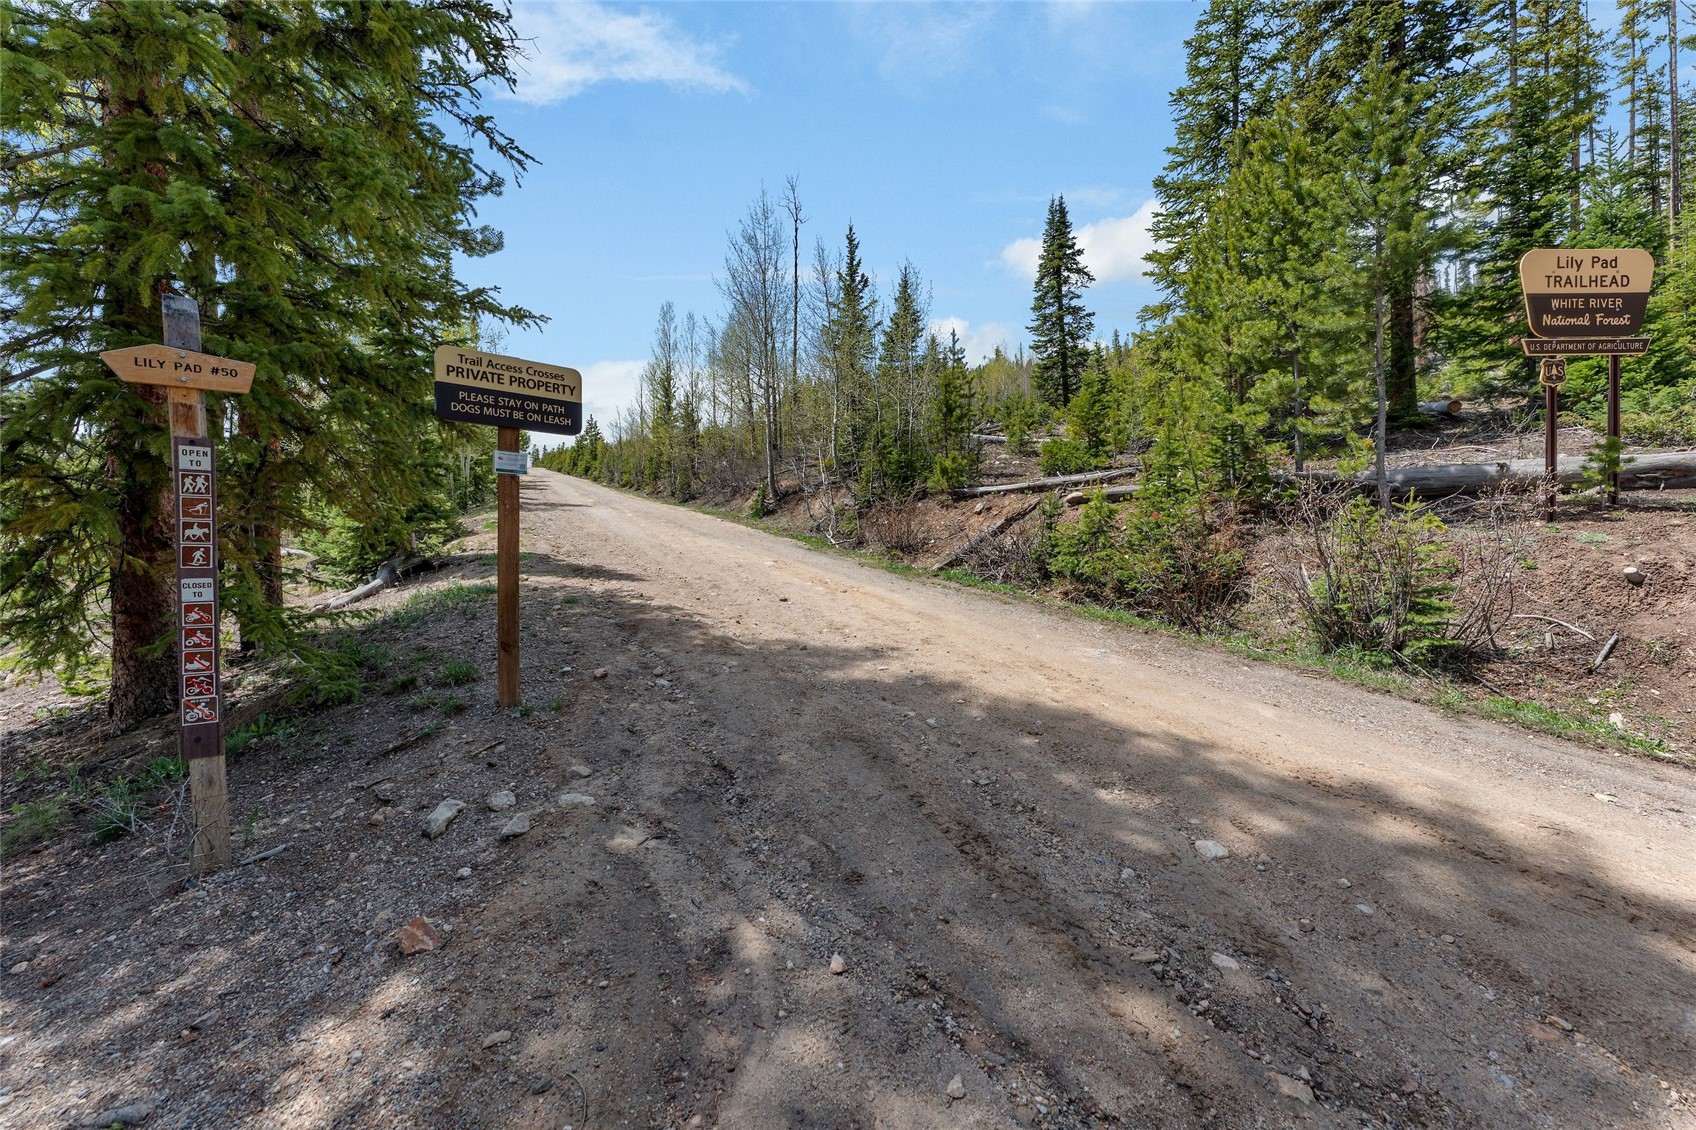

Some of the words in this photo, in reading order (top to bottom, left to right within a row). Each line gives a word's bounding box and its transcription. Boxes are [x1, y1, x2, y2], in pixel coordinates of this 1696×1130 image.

[1556, 255, 1584, 272] Lily
[1591, 255, 1618, 269] Pad
[1544, 274, 1630, 288] TRAILHEAD
[1551, 298, 1585, 309] WHITE
[1589, 298, 1623, 309] RIVER
[1542, 313, 1590, 326] National
[1595, 313, 1631, 326] Forest
[1530, 343, 1541, 351] U.S.
[1543, 343, 1586, 351] DEPARTMENT
[1587, 343, 1596, 351] OF
[1598, 342, 1644, 350] AGRICULTURE
[134, 356, 166, 369] LILY
[174, 362, 202, 374] PAD
[210, 366, 238, 378] #50
[457, 353, 483, 367] Trail
[486, 359, 523, 374] Access
[526, 366, 565, 382] Crosses
[446, 364, 505, 385] PRIVATE
[509, 375, 576, 396] PROPERTY
[459, 391, 495, 405] PLEASE
[498, 397, 523, 408] STAY
[524, 400, 539, 411] ON
[542, 403, 565, 415] PATH
[451, 402, 480, 415] DOGS
[483, 406, 511, 419] MUST
[513, 410, 524, 420] BE
[526, 412, 542, 422] ON
[543, 414, 572, 426] LEASH
[181, 448, 208, 458] OPEN
[189, 459, 202, 467] TO
[182, 582, 212, 590] CLOSED
